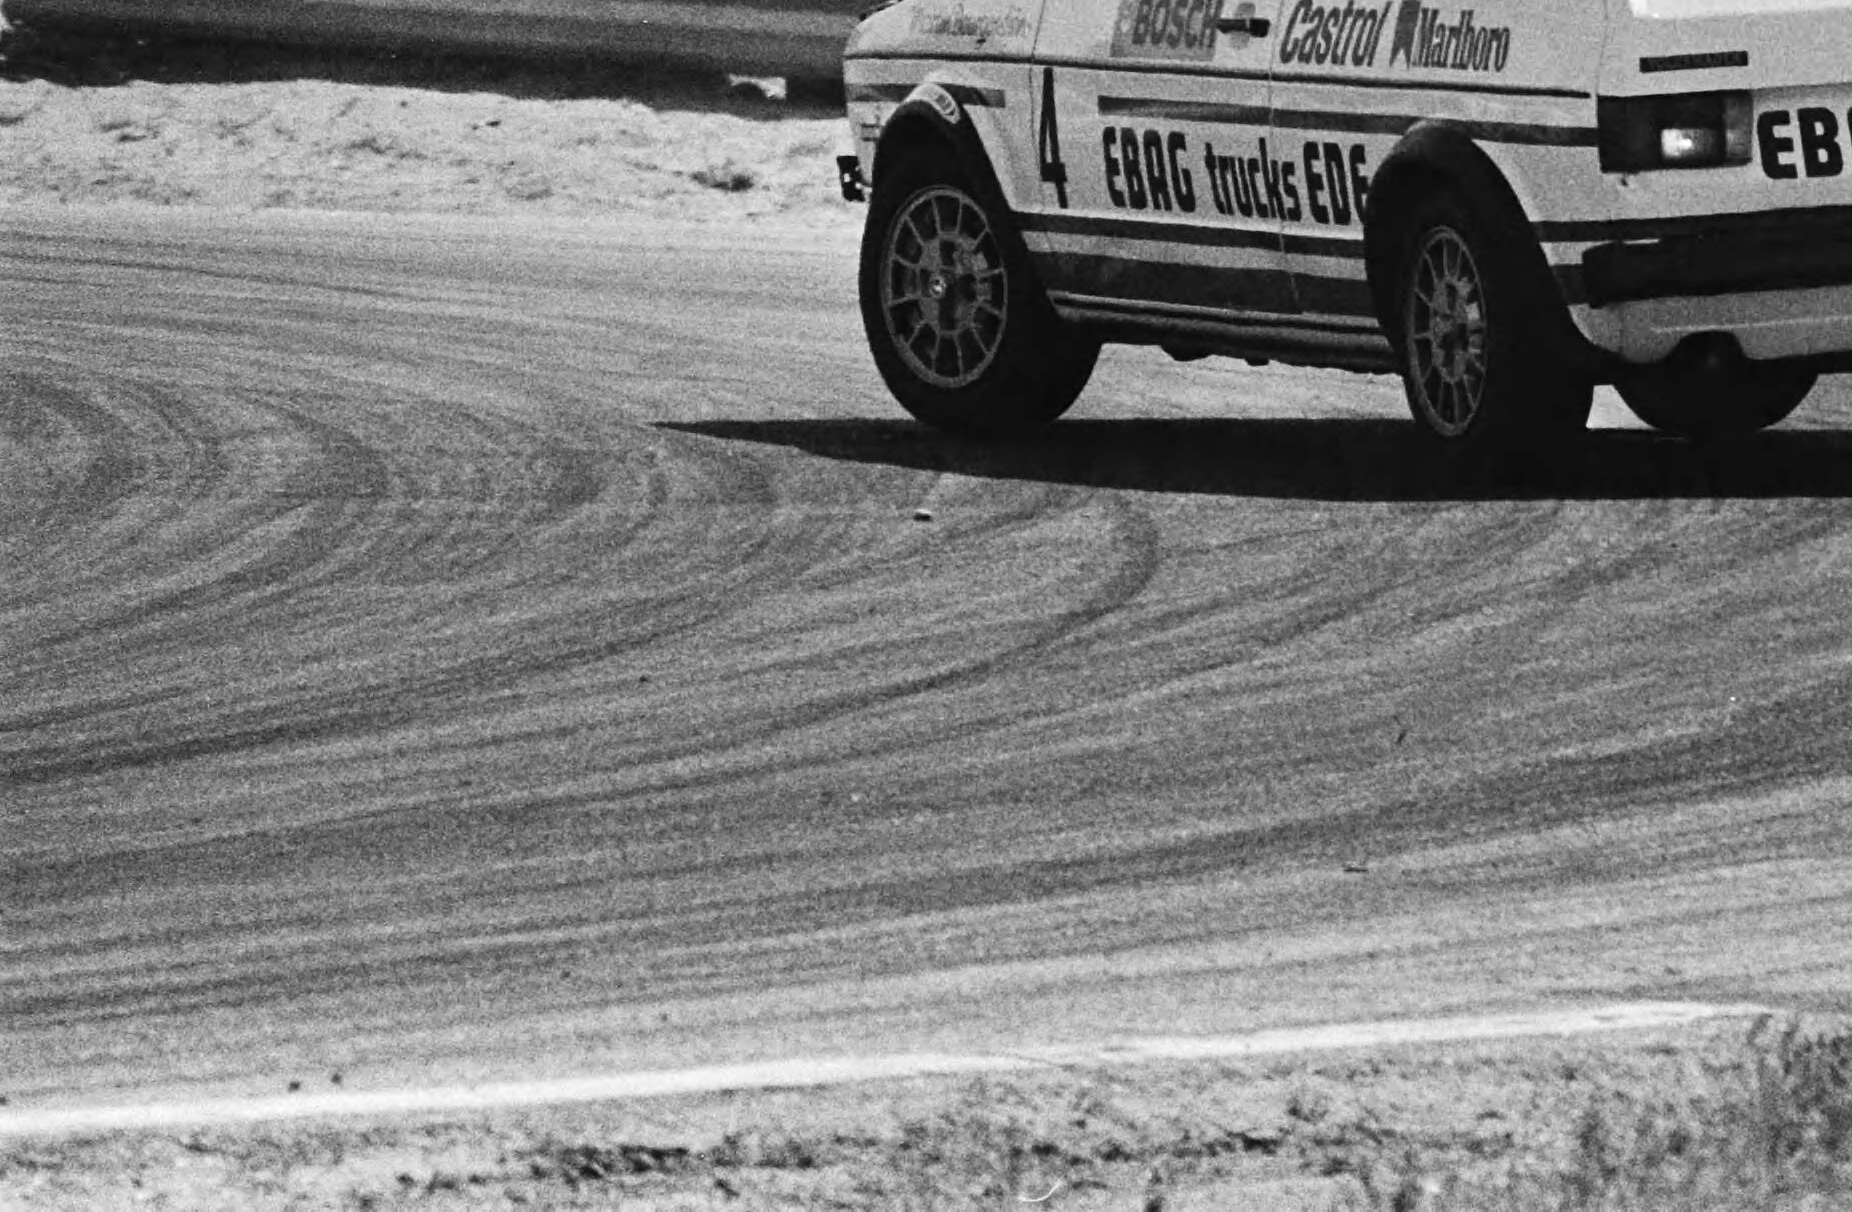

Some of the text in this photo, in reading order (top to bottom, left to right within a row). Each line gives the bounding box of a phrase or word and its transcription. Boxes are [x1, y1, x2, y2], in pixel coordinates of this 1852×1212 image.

[1411, 6, 1511, 73] Marlboro
[1039, 66, 1068, 209] 4
[1103, 126, 1370, 226] EBAG trucks EDE
